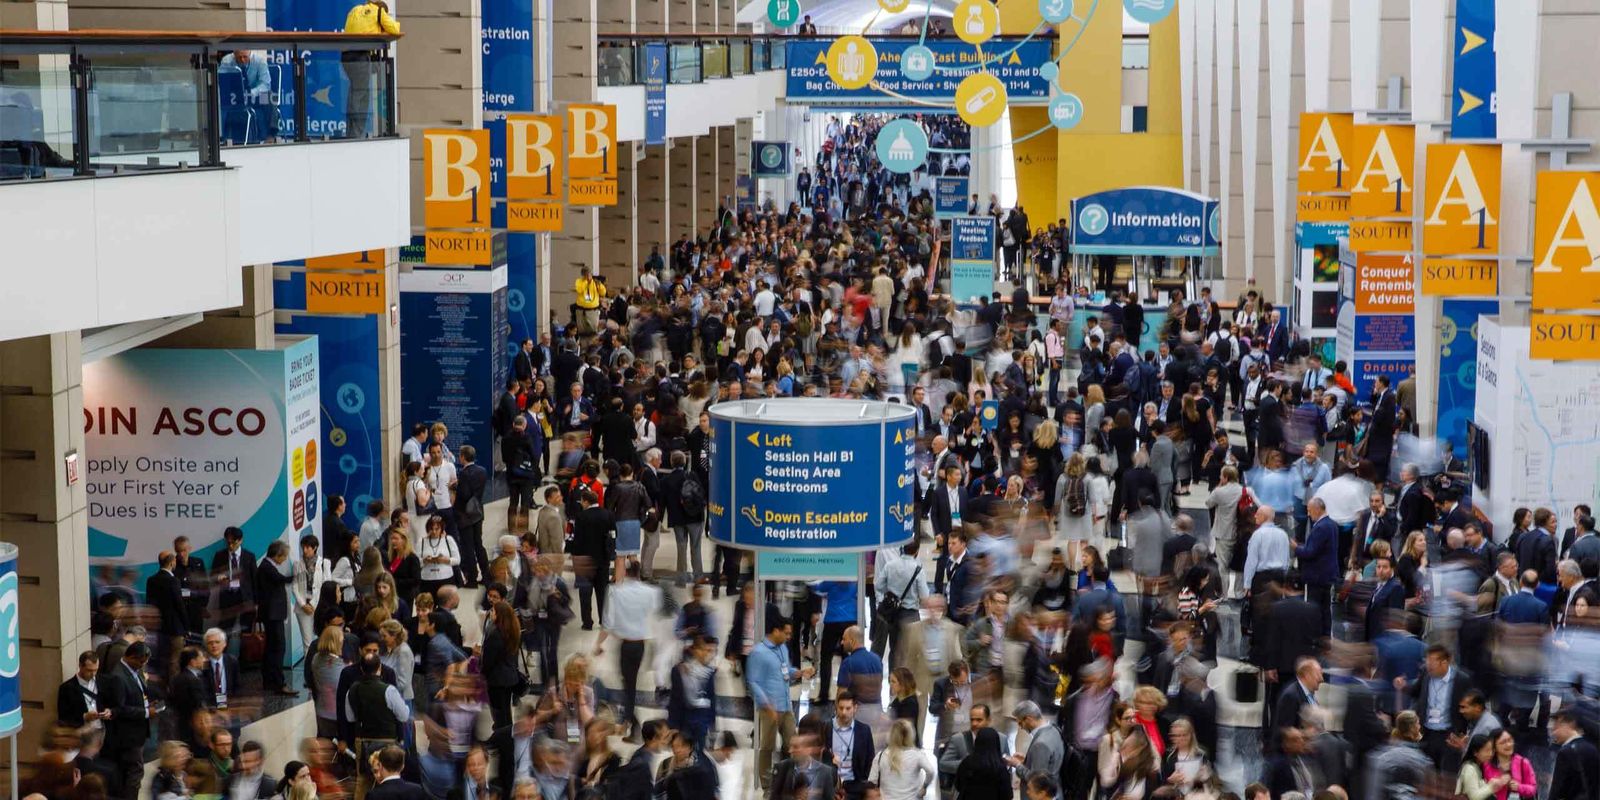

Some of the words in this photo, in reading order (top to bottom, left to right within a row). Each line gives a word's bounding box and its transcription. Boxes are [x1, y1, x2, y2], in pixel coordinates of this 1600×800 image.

[880, 53, 901, 63] Ahe
[876, 69, 898, 77] rown
[1014, 67, 1030, 77] and
[806, 81, 823, 91] Bag
[902, 81, 934, 90] Service
[943, 81, 960, 90] Shu
[571, 184, 614, 195] NORTH
[510, 206, 560, 220] NORTH
[1300, 201, 1348, 212] SOUTH
[1112, 212, 1201, 227] Information
[958, 234, 988, 242] Feedback
[961, 227, 987, 236] Meeting
[1352, 226, 1409, 239] SOUTH
[404, 245, 426, 253] Reco
[429, 238, 487, 251] NORTH
[1361, 266, 1410, 280] Conquer
[1426, 265, 1494, 280] SOUTH
[310, 281, 380, 298] NORTH
[1368, 293, 1415, 304] Advanc
[153, 407, 266, 437] ASCO
[765, 433, 792, 447] Left
[765, 450, 810, 462] Session
[814, 450, 836, 462] Hall
[840, 450, 853, 462] B1
[136, 456, 197, 473] Onsite
[204, 456, 239, 472] and
[765, 465, 809, 480] Seating
[813, 466, 840, 478] Area
[124, 479, 165, 495] First
[172, 479, 213, 495] Year
[220, 479, 239, 495] of
[765, 480, 828, 493] Restrooms
[90, 502, 137, 518] Dues
[144, 502, 158, 518] is
[765, 511, 800, 524] Down
[805, 510, 868, 524] Escalator
[765, 526, 837, 540] Registration
